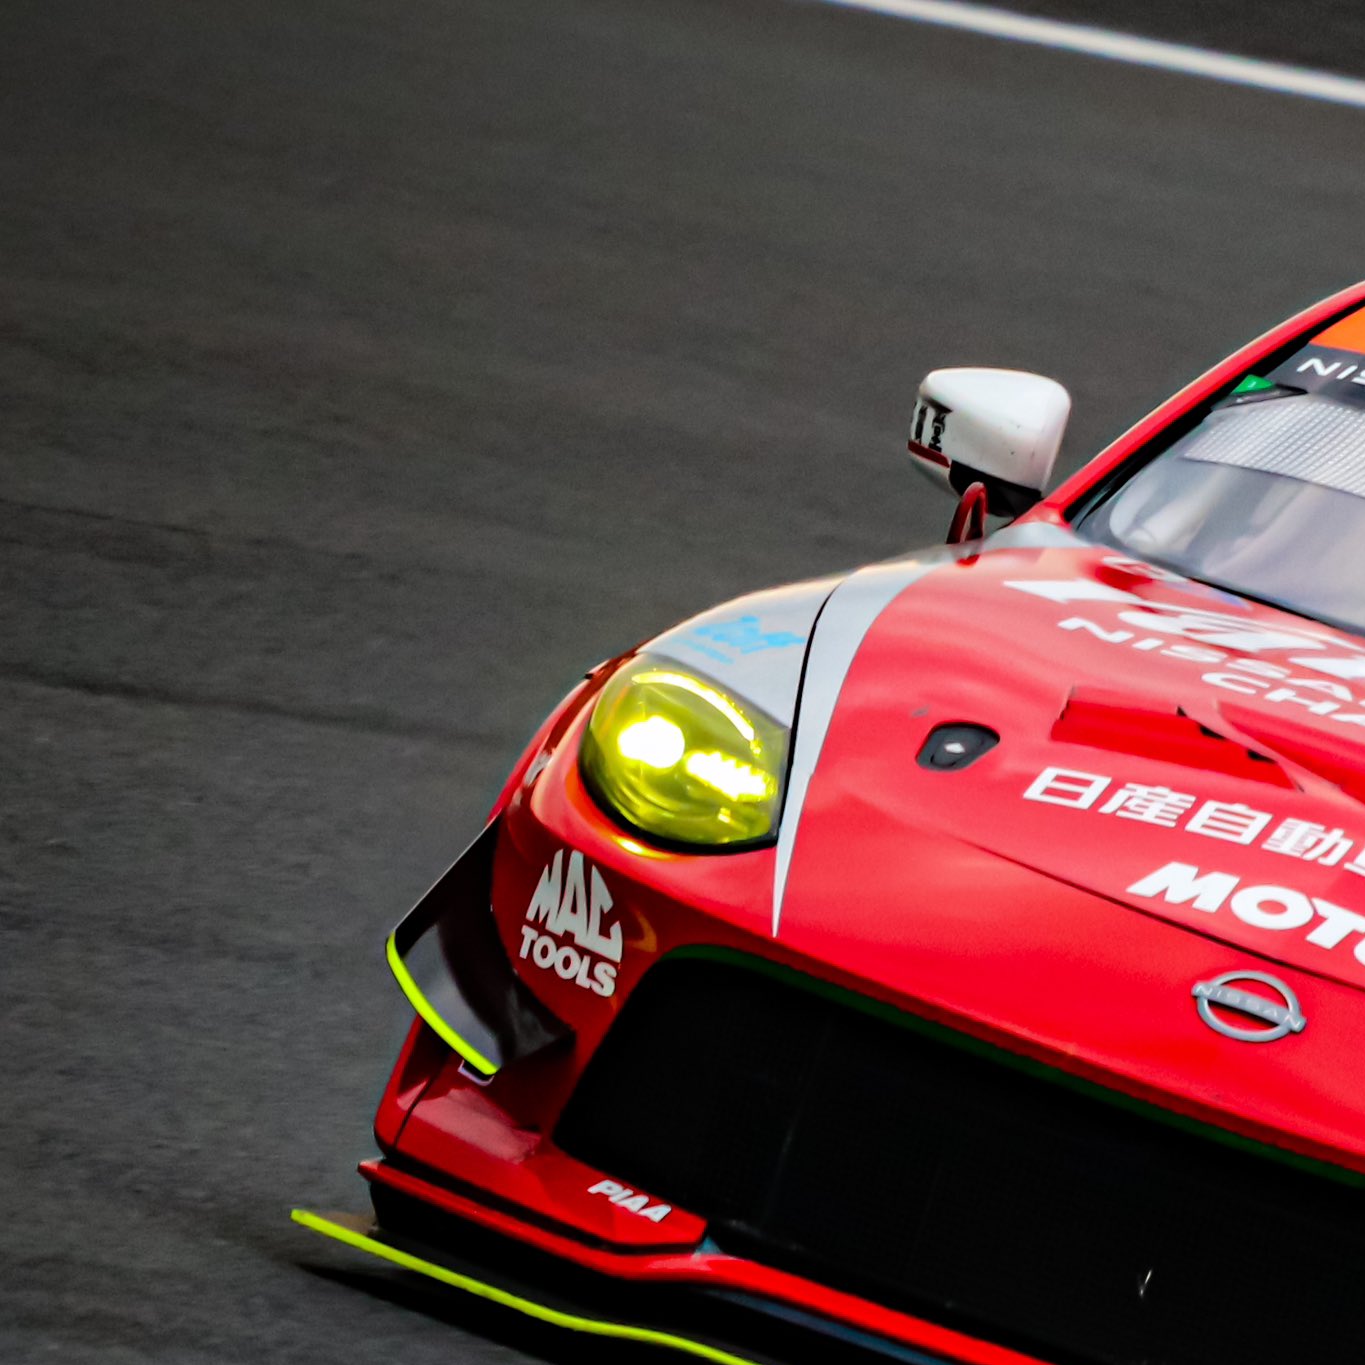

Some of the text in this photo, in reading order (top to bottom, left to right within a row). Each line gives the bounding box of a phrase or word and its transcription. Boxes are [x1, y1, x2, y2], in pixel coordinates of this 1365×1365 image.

[526, 849, 623, 963] MAC
[519, 925, 618, 998] TOOLS
[587, 1179, 672, 1223] PIAA
